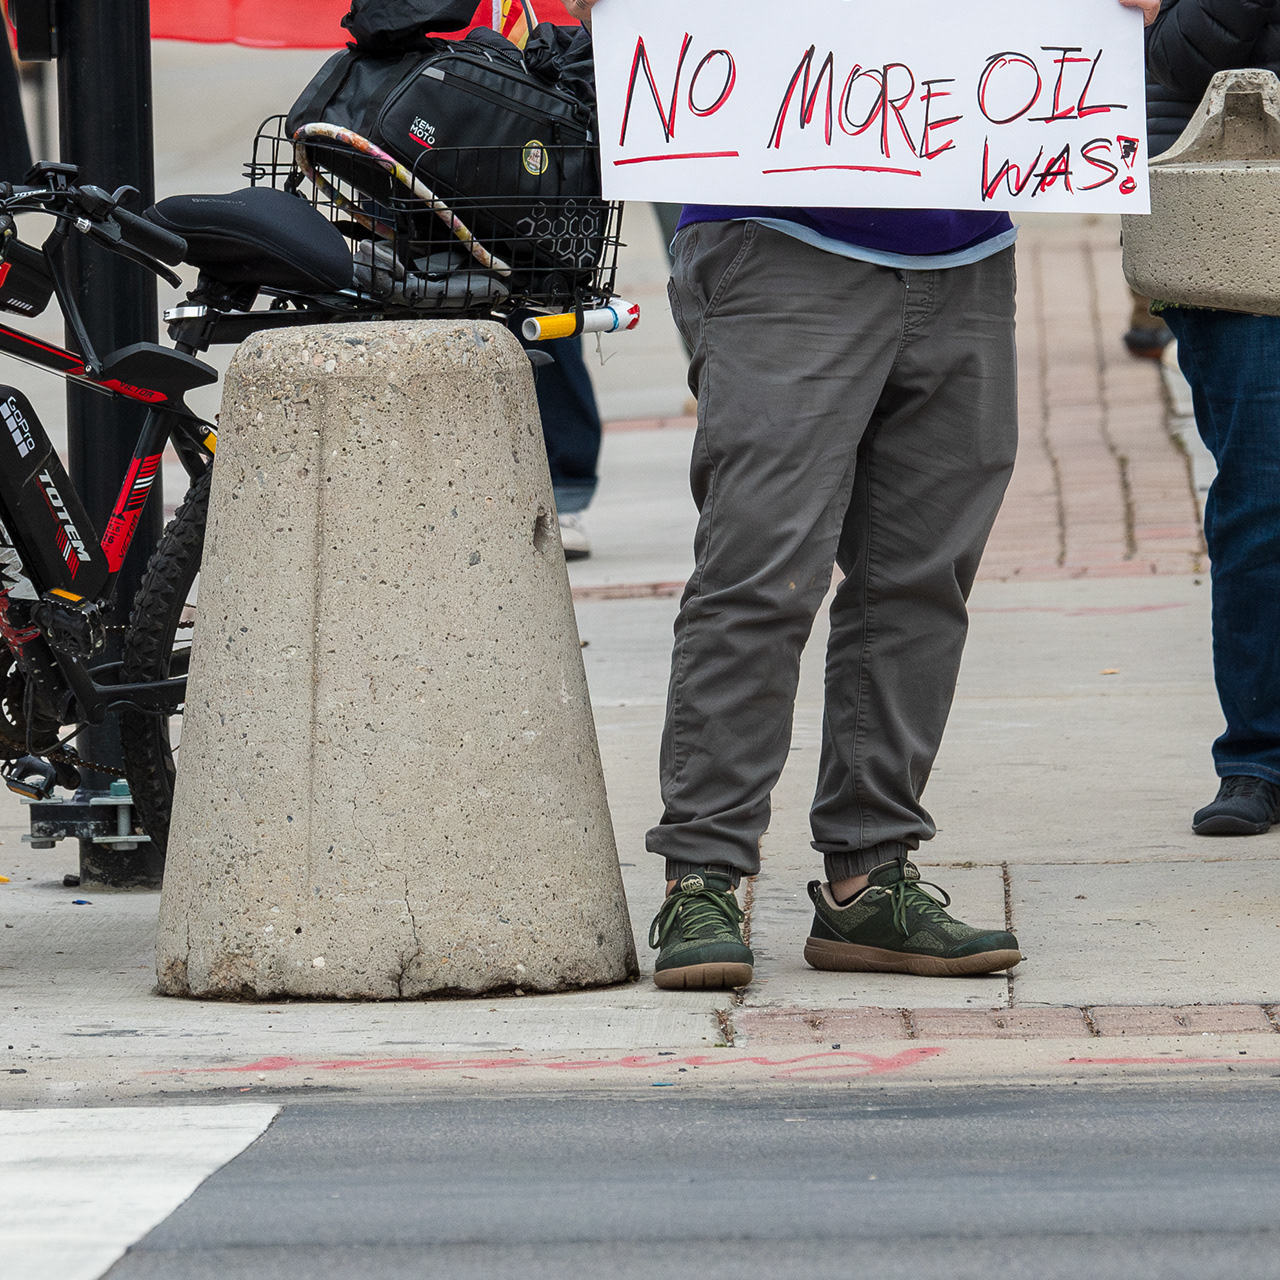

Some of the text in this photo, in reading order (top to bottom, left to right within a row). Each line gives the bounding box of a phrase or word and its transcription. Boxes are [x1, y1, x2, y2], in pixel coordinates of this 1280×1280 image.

[619, 32, 1128, 161] NO MORE OIL
[410, 124, 436, 145] MOTO
[414, 116, 436, 135] KEMI
[7, 396, 36, 451] GoPro
[37, 468, 92, 562] TOTEM
